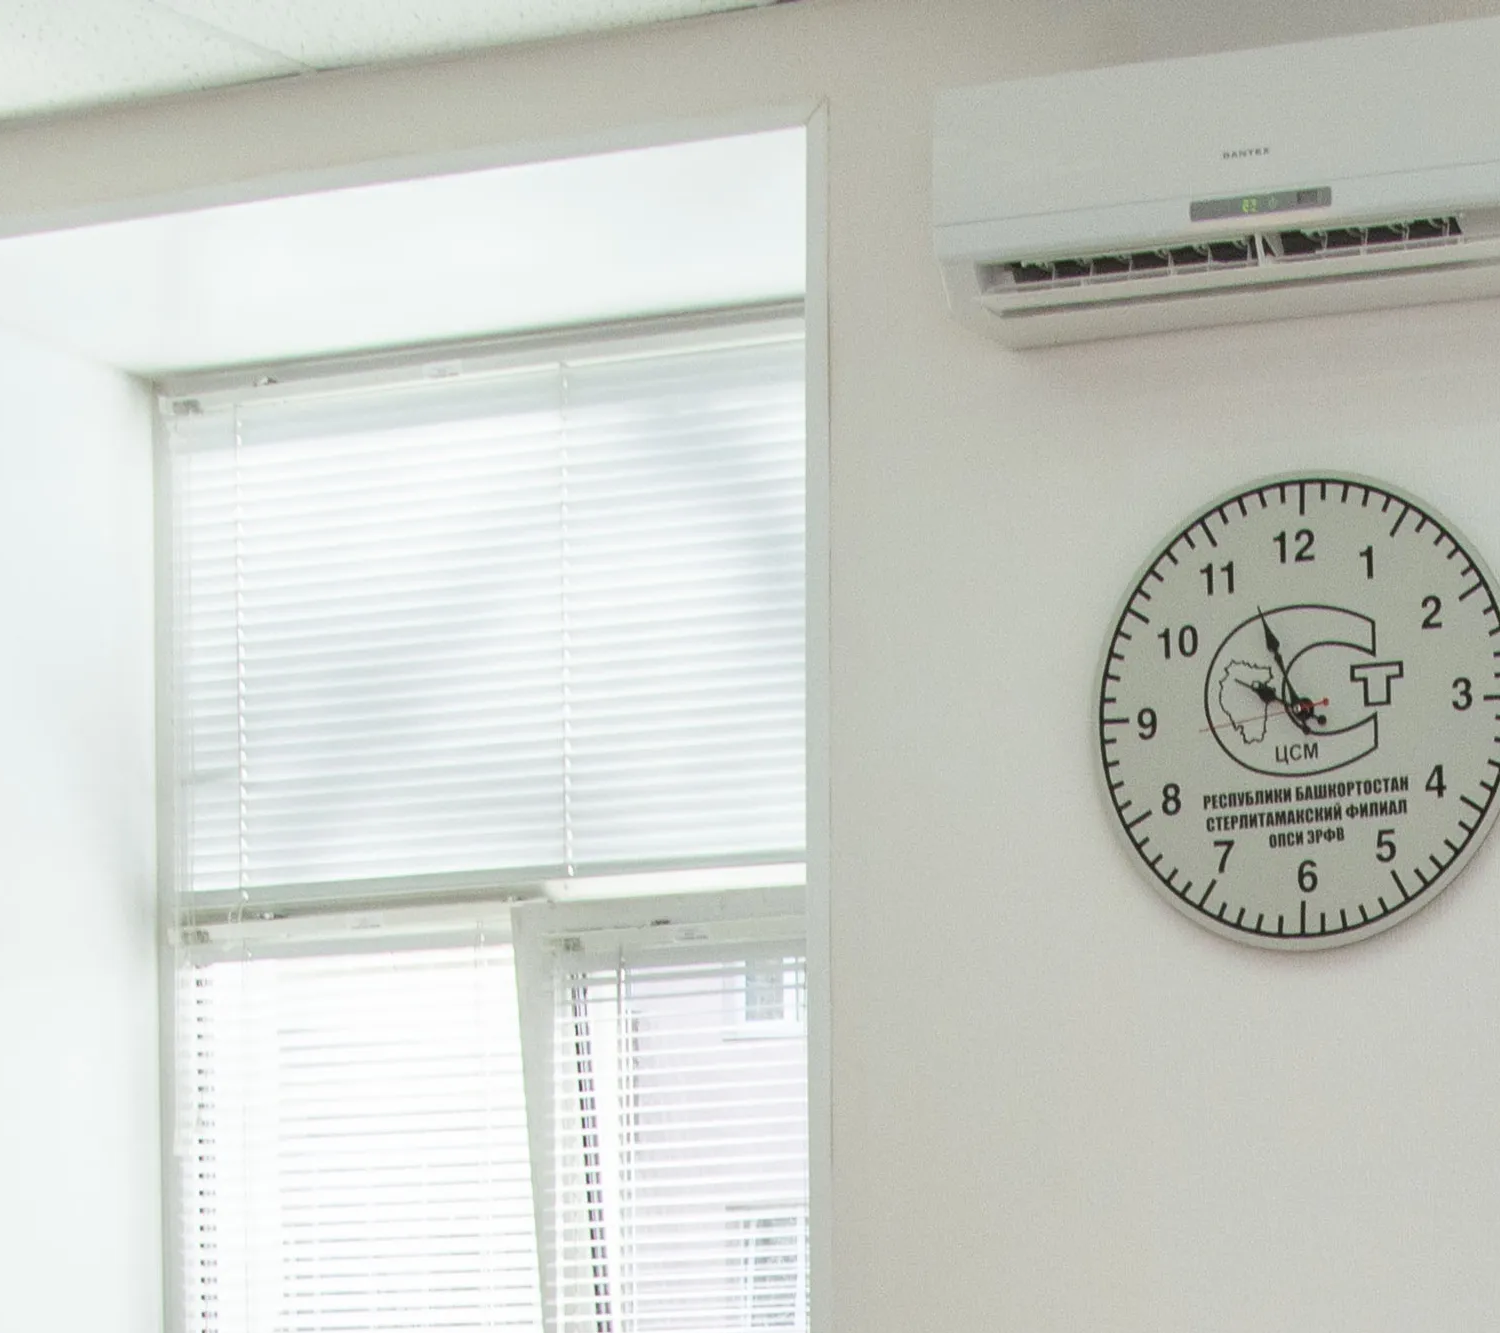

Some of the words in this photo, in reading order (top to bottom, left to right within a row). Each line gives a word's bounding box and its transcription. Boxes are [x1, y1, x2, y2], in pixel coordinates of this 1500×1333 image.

[1273, 528, 1316, 565] 12
[1359, 545, 1374, 580] 1
[1199, 560, 1235, 596] 11
[1421, 594, 1443, 630] 2
[1157, 624, 1199, 660] 10
[1451, 676, 1473, 712] 3
[1137, 707, 1158, 741] 9
[1275, 742, 1319, 765] ЦСМ
[1203, 787, 1292, 810] РЕСПУБЛИКИ
[1295, 775, 1409, 802] БАШКОРТОСТАН
[1424, 763, 1447, 799] 4
[1161, 782, 1182, 817] 8
[1206, 803, 1342, 832] СТЕРЛИТАМАКСКИЙ
[1345, 799, 1408, 820] ФИЛИАЛ
[1213, 839, 1235, 874] 7
[1268, 832, 1304, 849] ОПСИ
[1375, 828, 1397, 863] 5
[1297, 859, 1318, 894] 6
